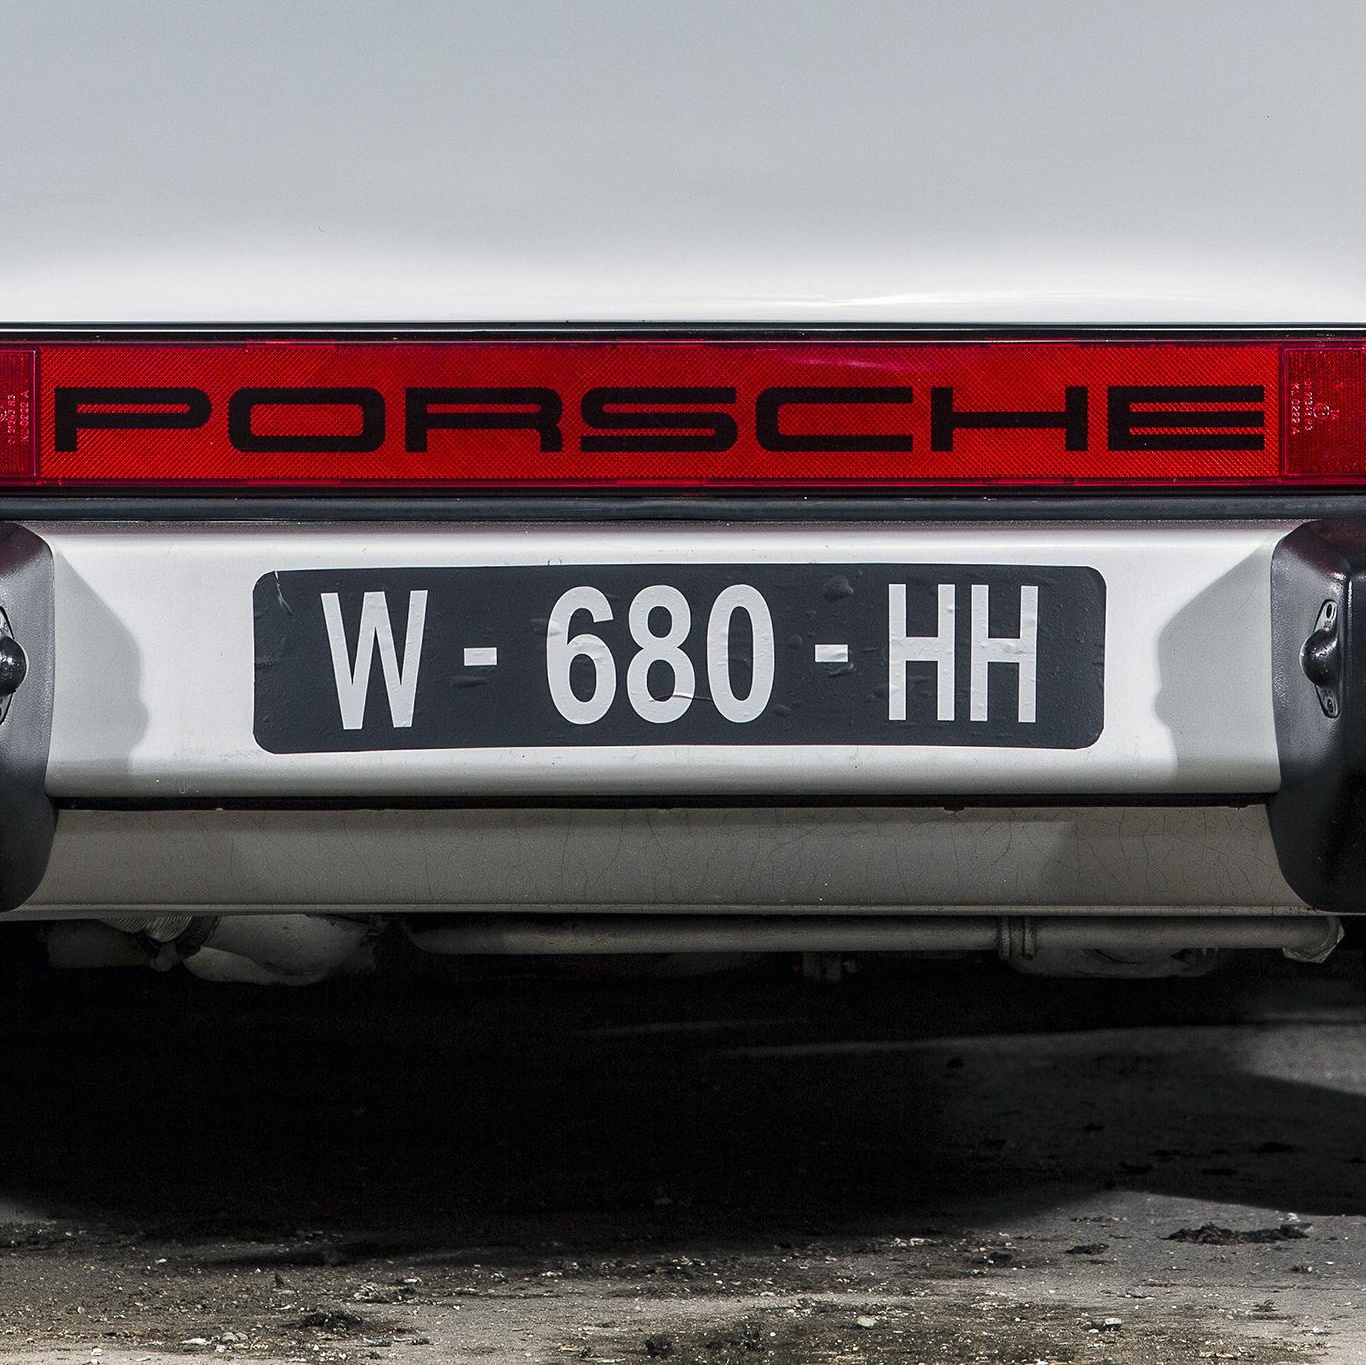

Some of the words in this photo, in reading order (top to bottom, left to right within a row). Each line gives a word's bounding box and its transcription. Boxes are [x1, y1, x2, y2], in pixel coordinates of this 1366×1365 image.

[20, 401, 29, 427] 0222
[54, 385, 1265, 453] PORSCHE
[1291, 399, 1301, 423] 0222
[320, 589, 428, 730] W
[546, 584, 776, 726] 680
[887, 583, 1039, 722] HH
